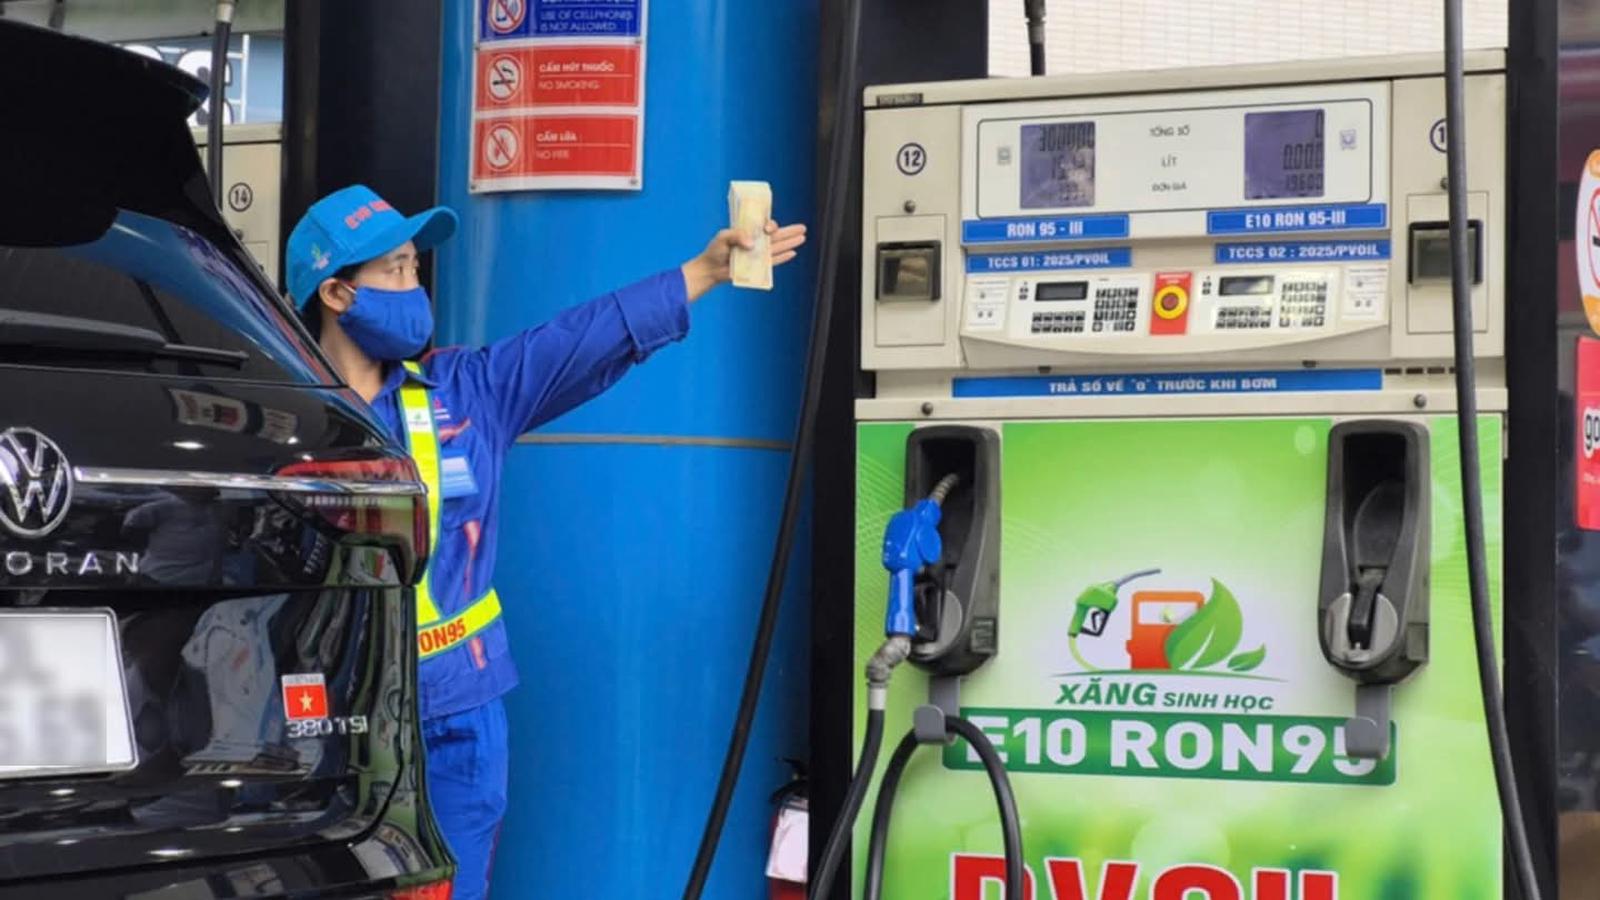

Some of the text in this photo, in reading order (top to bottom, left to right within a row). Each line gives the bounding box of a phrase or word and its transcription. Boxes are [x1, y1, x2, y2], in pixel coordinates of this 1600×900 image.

[538, 80, 553, 89] NO
[903, 151, 920, 167] 12
[233, 189, 248, 205] 14
[1245, 210, 1346, 228] E10 RON 95-III
[1007, 223, 1035, 236] RON
[1040, 222, 1056, 235] 95
[1070, 221, 1083, 234] III
[1229, 247, 1264, 258] TCCS
[1269, 247, 1286, 257] 02
[1299, 244, 1379, 256] 2025/PVOIL
[988, 253, 1110, 269] TCCS 01: 2025/PVOIL
[1210, 379, 1236, 390] KHI
[417, 617, 467, 653] ON95
[1055, 678, 1275, 711] XĂNG SINH HỌC
